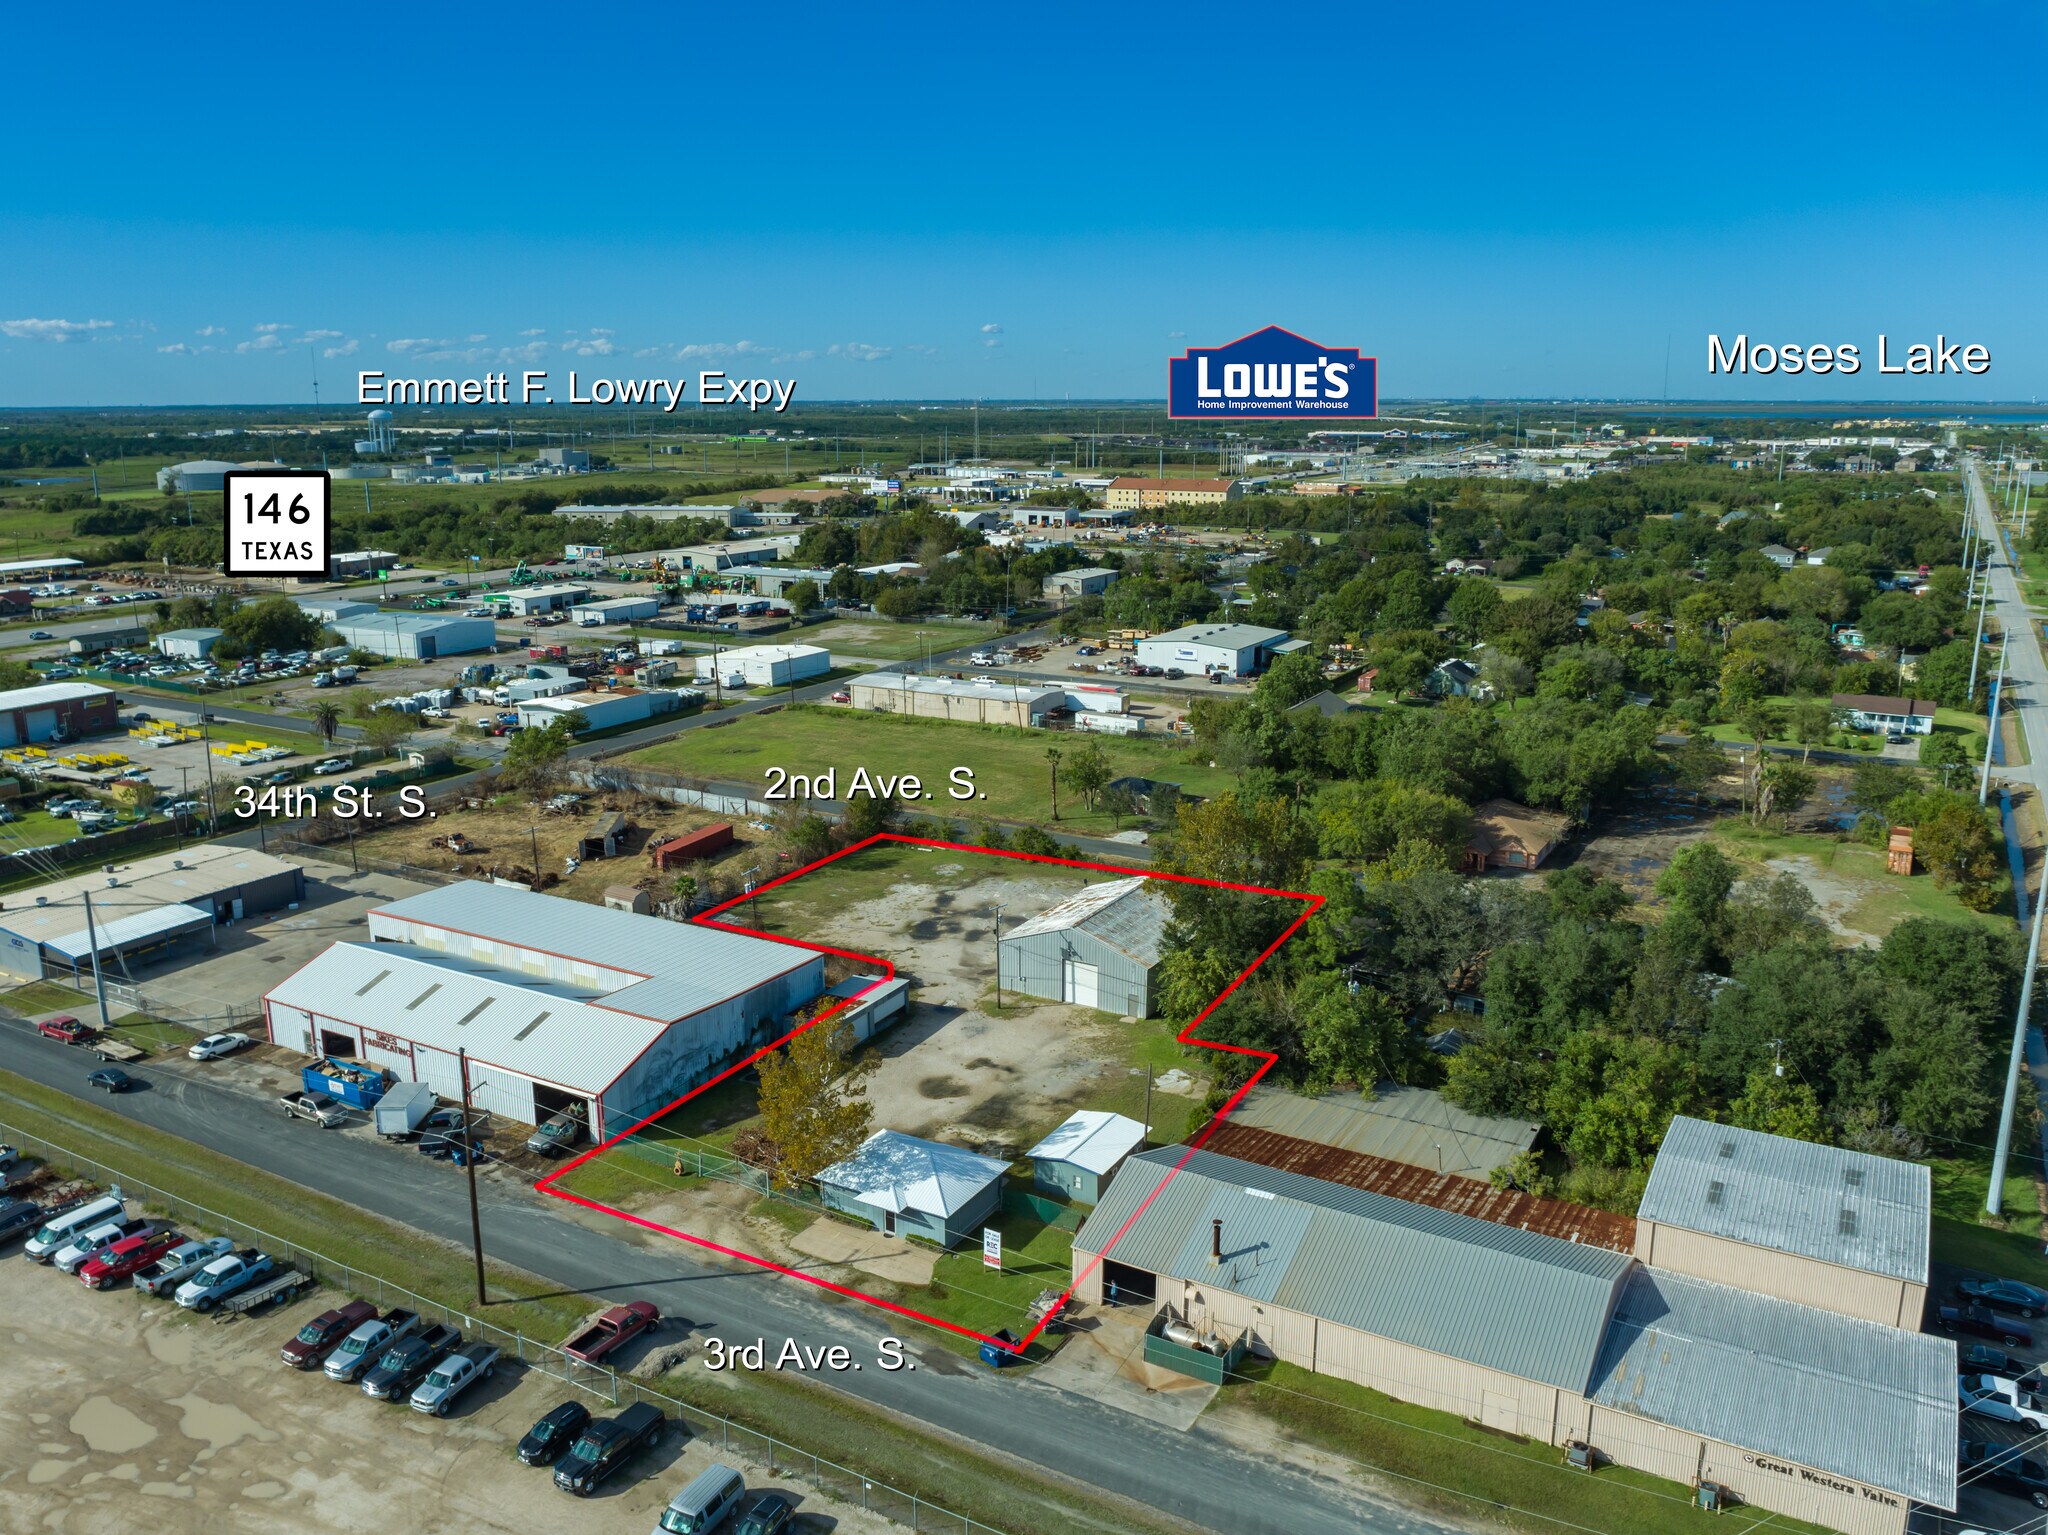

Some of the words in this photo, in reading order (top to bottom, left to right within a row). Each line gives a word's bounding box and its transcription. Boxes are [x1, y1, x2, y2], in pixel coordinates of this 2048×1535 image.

[363, 1036, 412, 1058] FABRICATING
[1755, 1457, 1794, 1477] Great
[1800, 1469, 1855, 1495] Western
[1862, 1487, 1899, 1508] Valve
